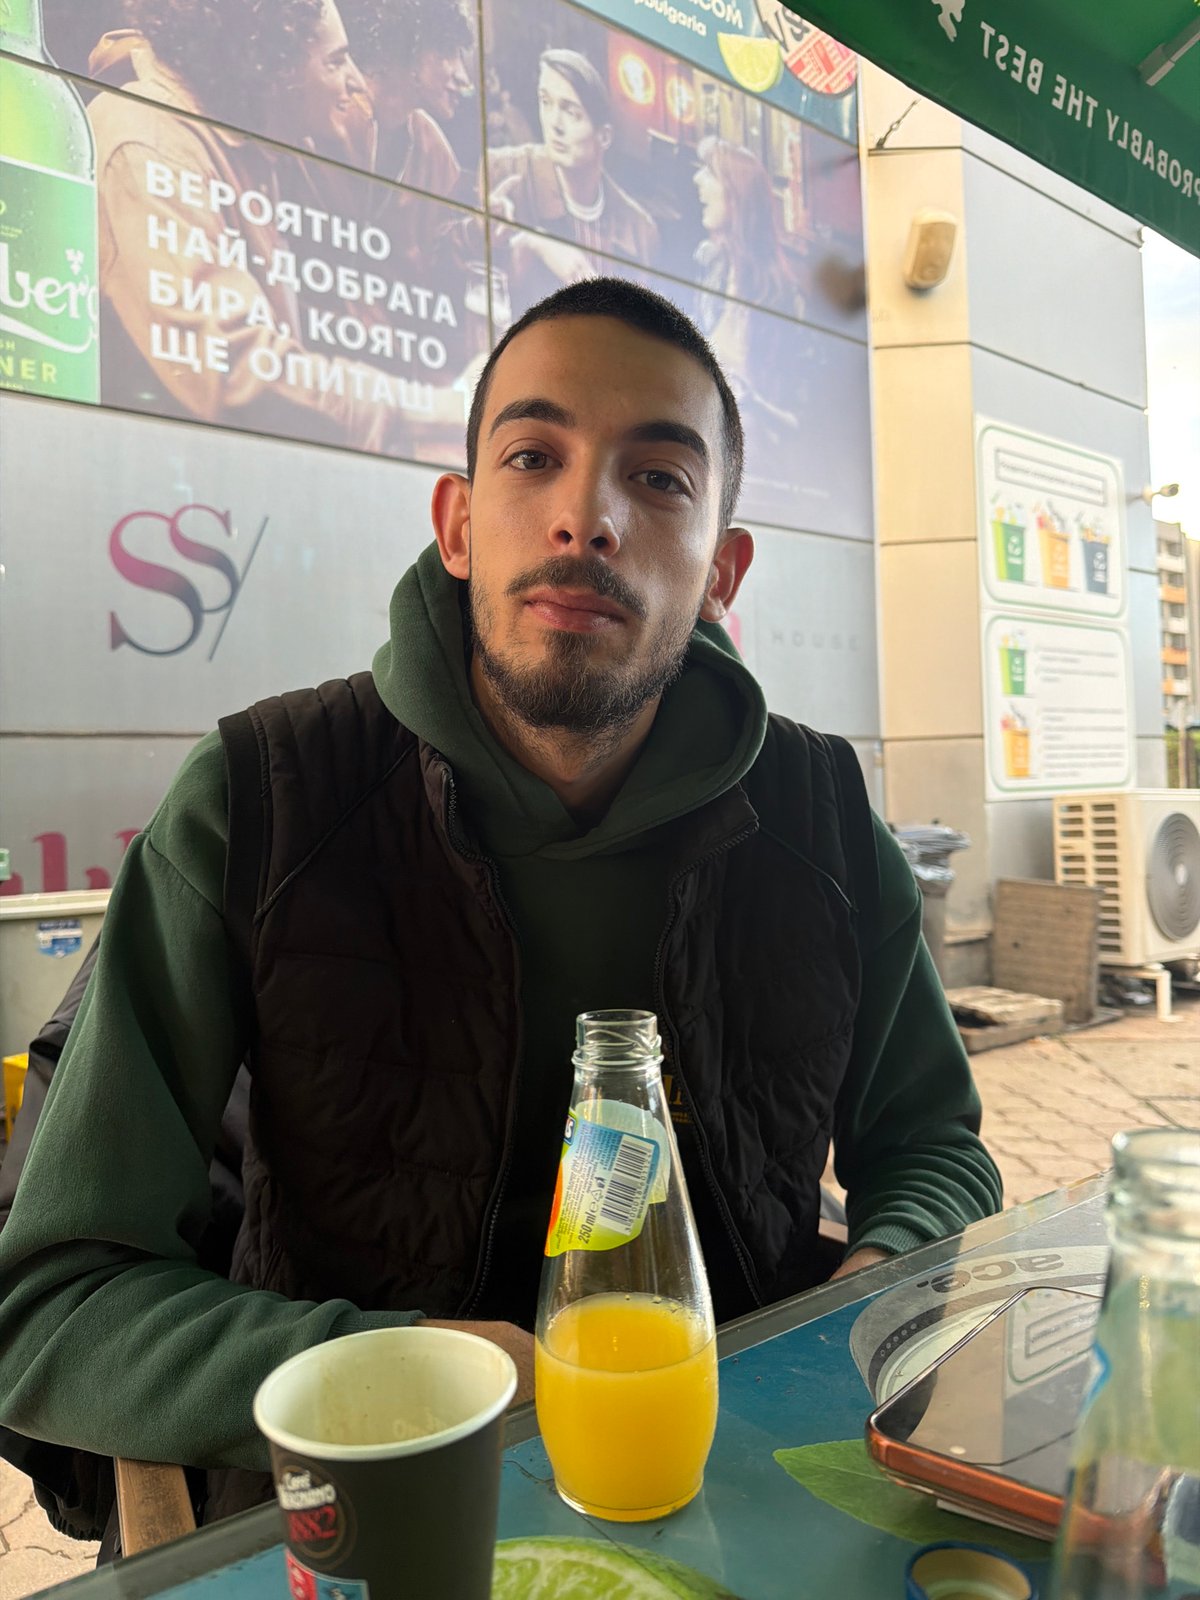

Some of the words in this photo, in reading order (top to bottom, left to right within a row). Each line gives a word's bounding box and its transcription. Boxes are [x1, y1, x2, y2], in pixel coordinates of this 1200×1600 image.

[145, 160, 391, 261] ВЕРОЯТНО
[147, 215, 457, 327] НАЙ-ДОБРАТА
[149, 270, 292, 340] БИРА,
[308, 308, 447, 370] КОЯТО
[151, 324, 230, 373] ЩЕ
[248, 348, 434, 412] ОПИТАШ
[578, 1224, 592, 1244] 250
